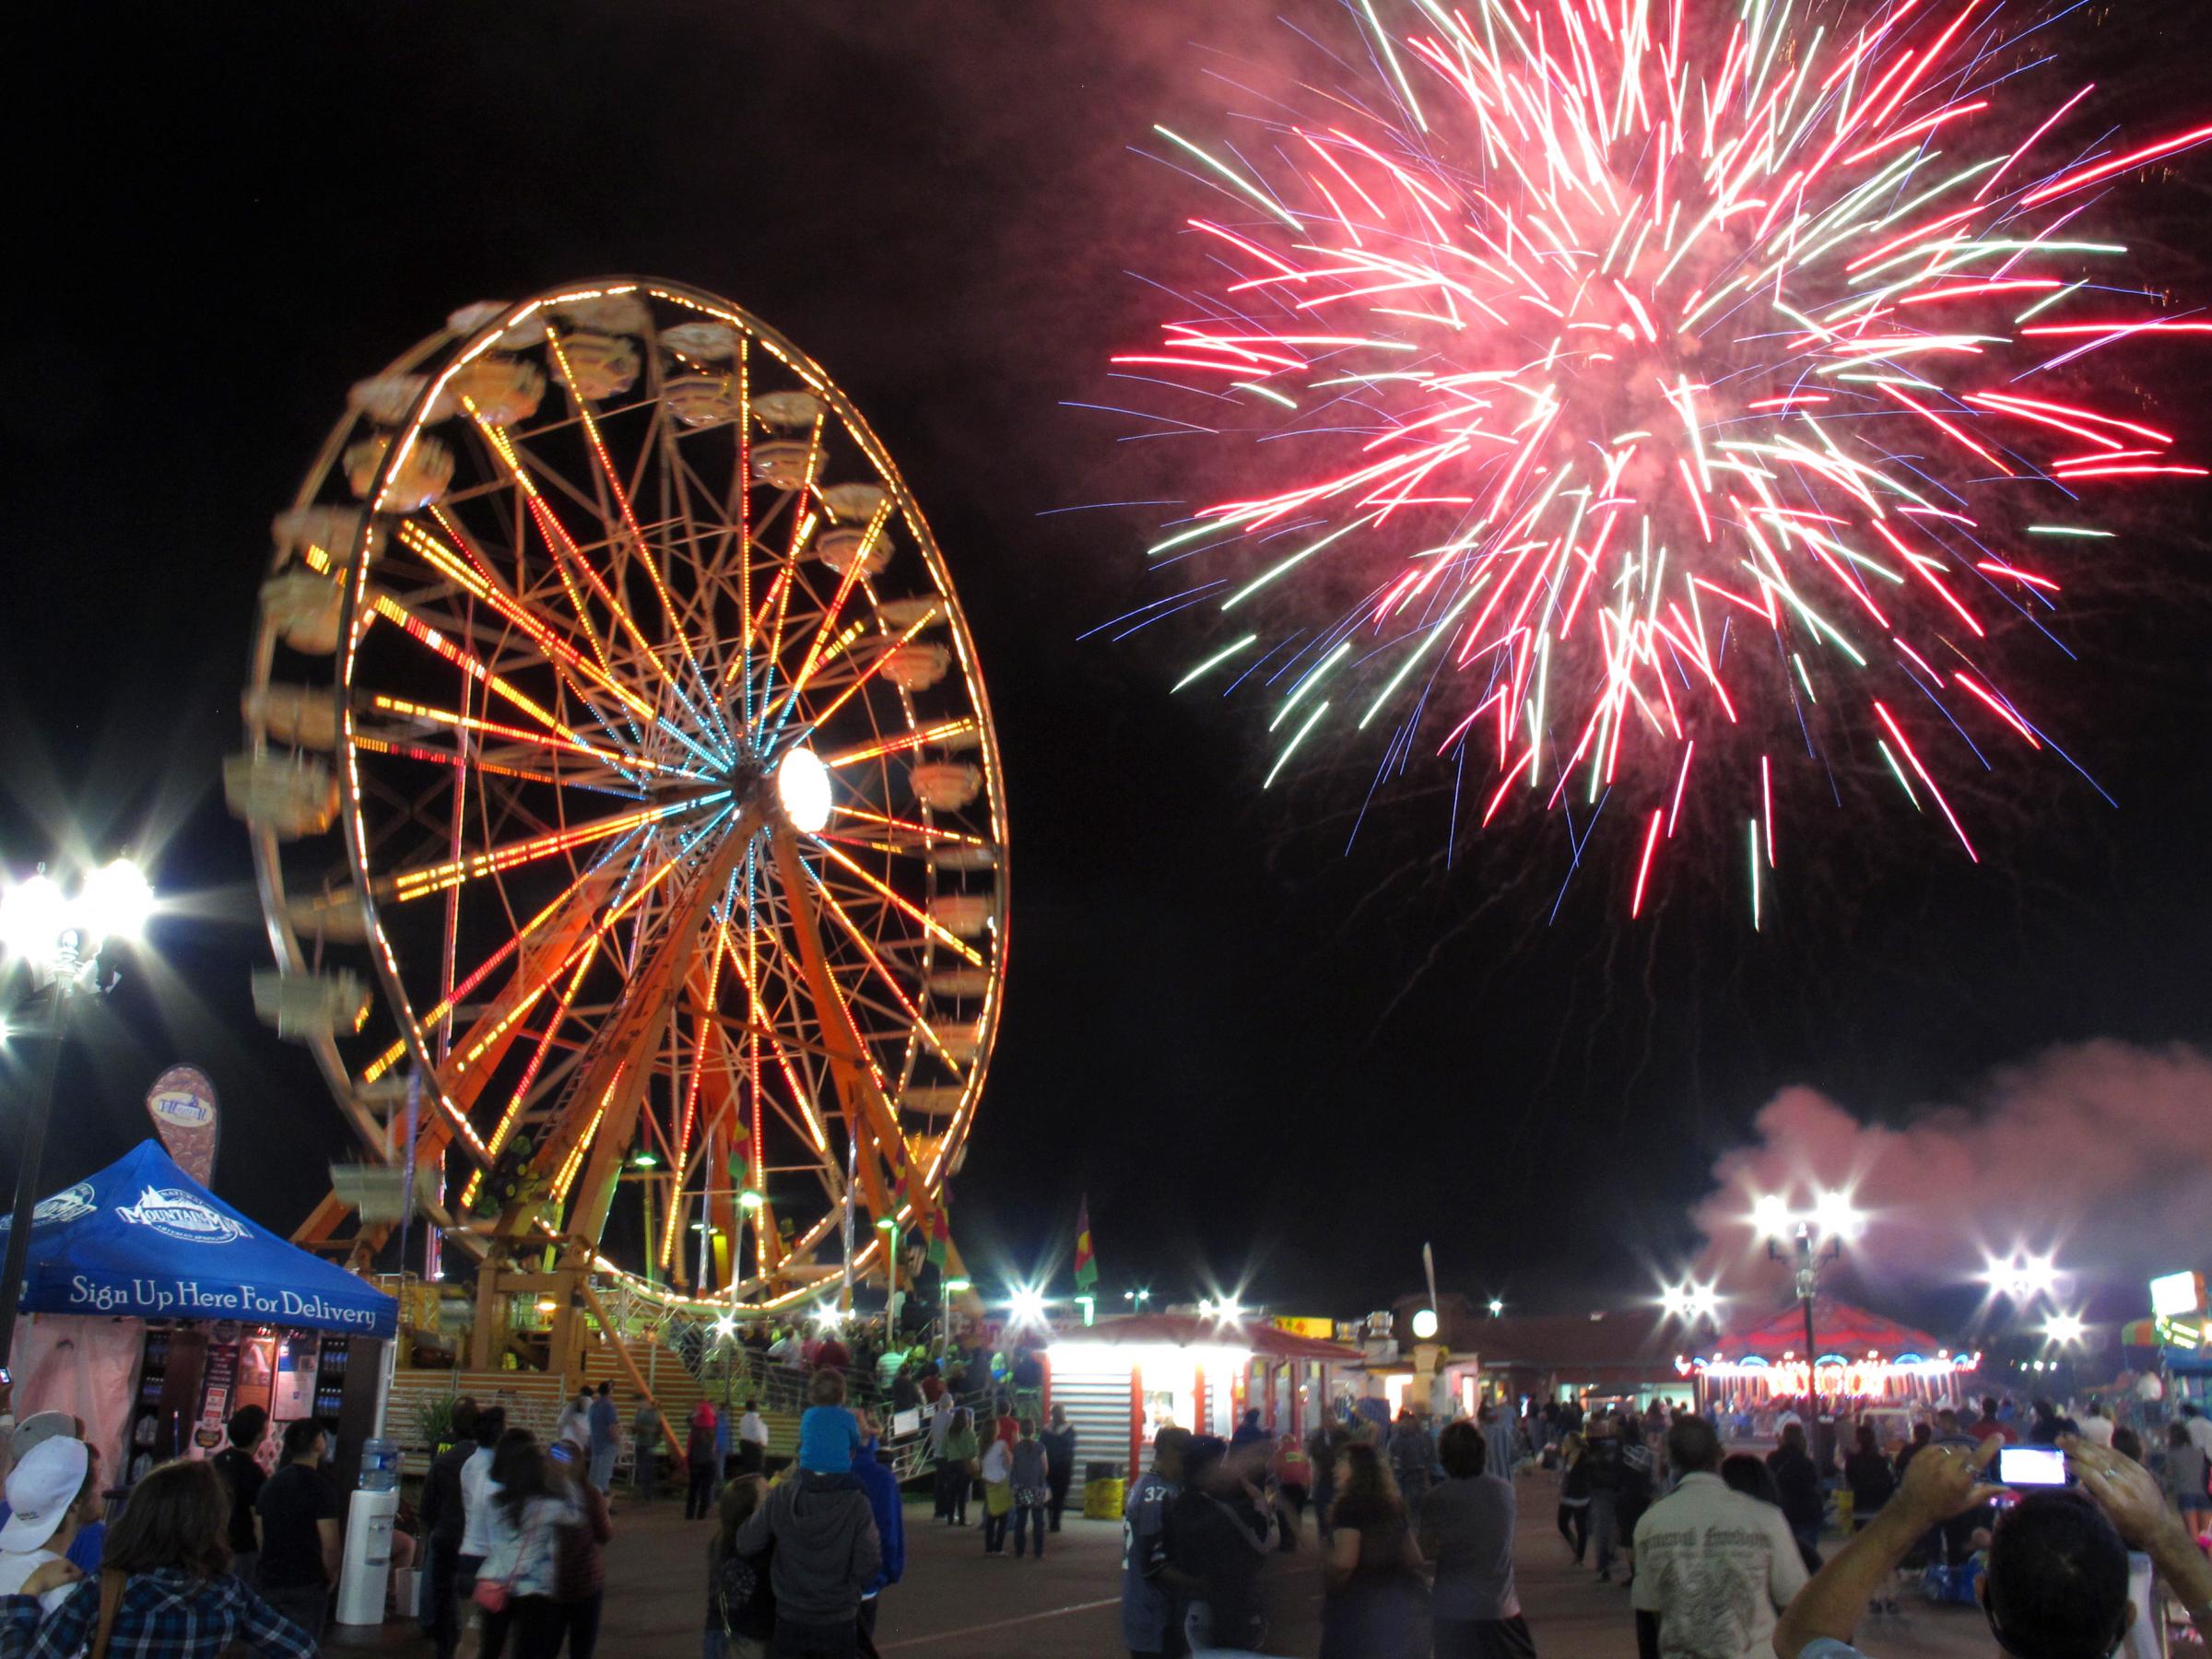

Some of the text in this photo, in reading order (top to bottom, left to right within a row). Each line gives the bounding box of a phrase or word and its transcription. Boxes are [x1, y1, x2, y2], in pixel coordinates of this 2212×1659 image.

[114, 1206, 205, 1226] MOUNTAIN
[69, 1275, 376, 1330] Sign Up Here For Delivery
[1144, 1486, 1167, 1502] 37
